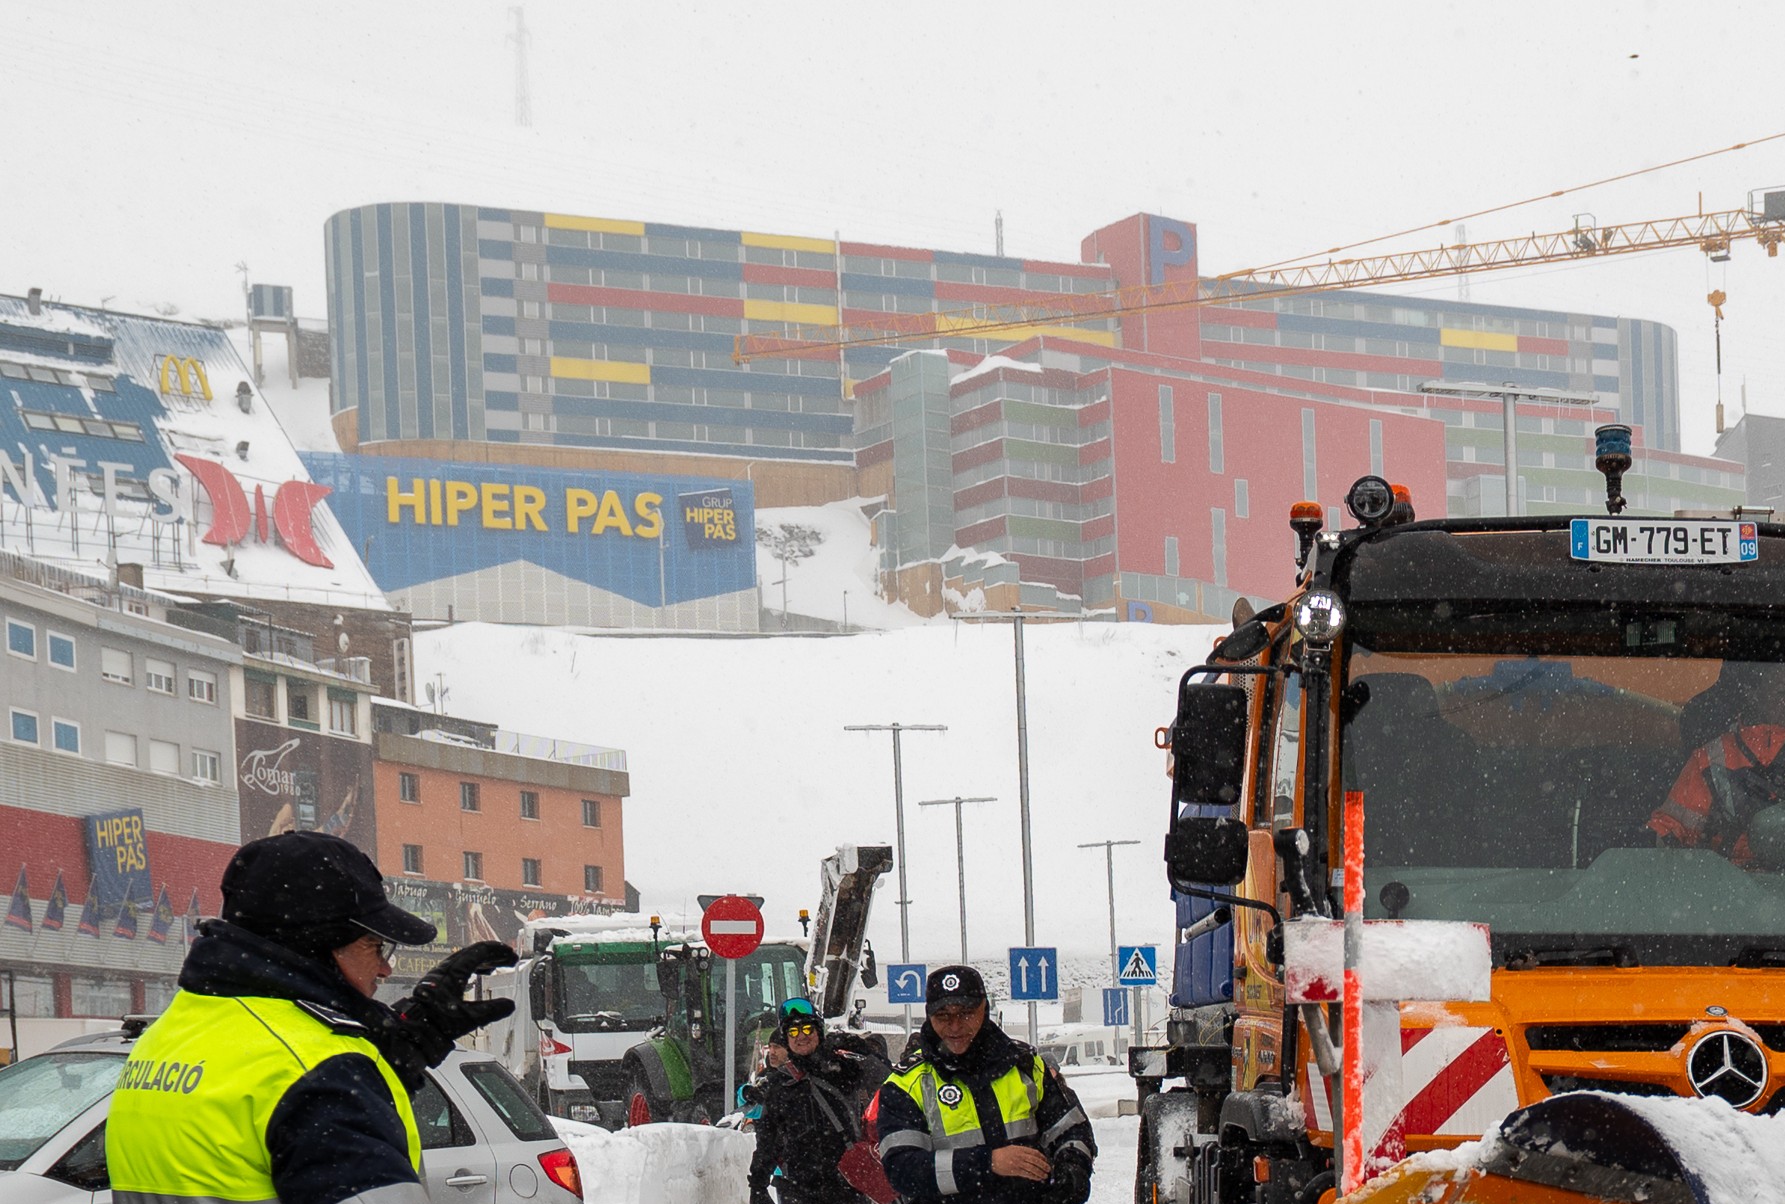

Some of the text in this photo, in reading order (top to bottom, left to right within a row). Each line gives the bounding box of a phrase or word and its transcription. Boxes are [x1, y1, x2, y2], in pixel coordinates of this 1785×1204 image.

[1149, 215, 1194, 292] P
[386, 475, 664, 539] HIPER PAS
[701, 495, 733, 509] GRUP
[685, 507, 735, 525] HIPER
[704, 523, 736, 541] PAS
[1595, 525, 1732, 555] GM-779-ET
[1578, 542, 1583, 551] F
[1740, 542, 1756, 556] 09
[96, 815, 143, 848] HIPER
[116, 843, 146, 874] PAS
[520, 895, 557, 911] Serrano
